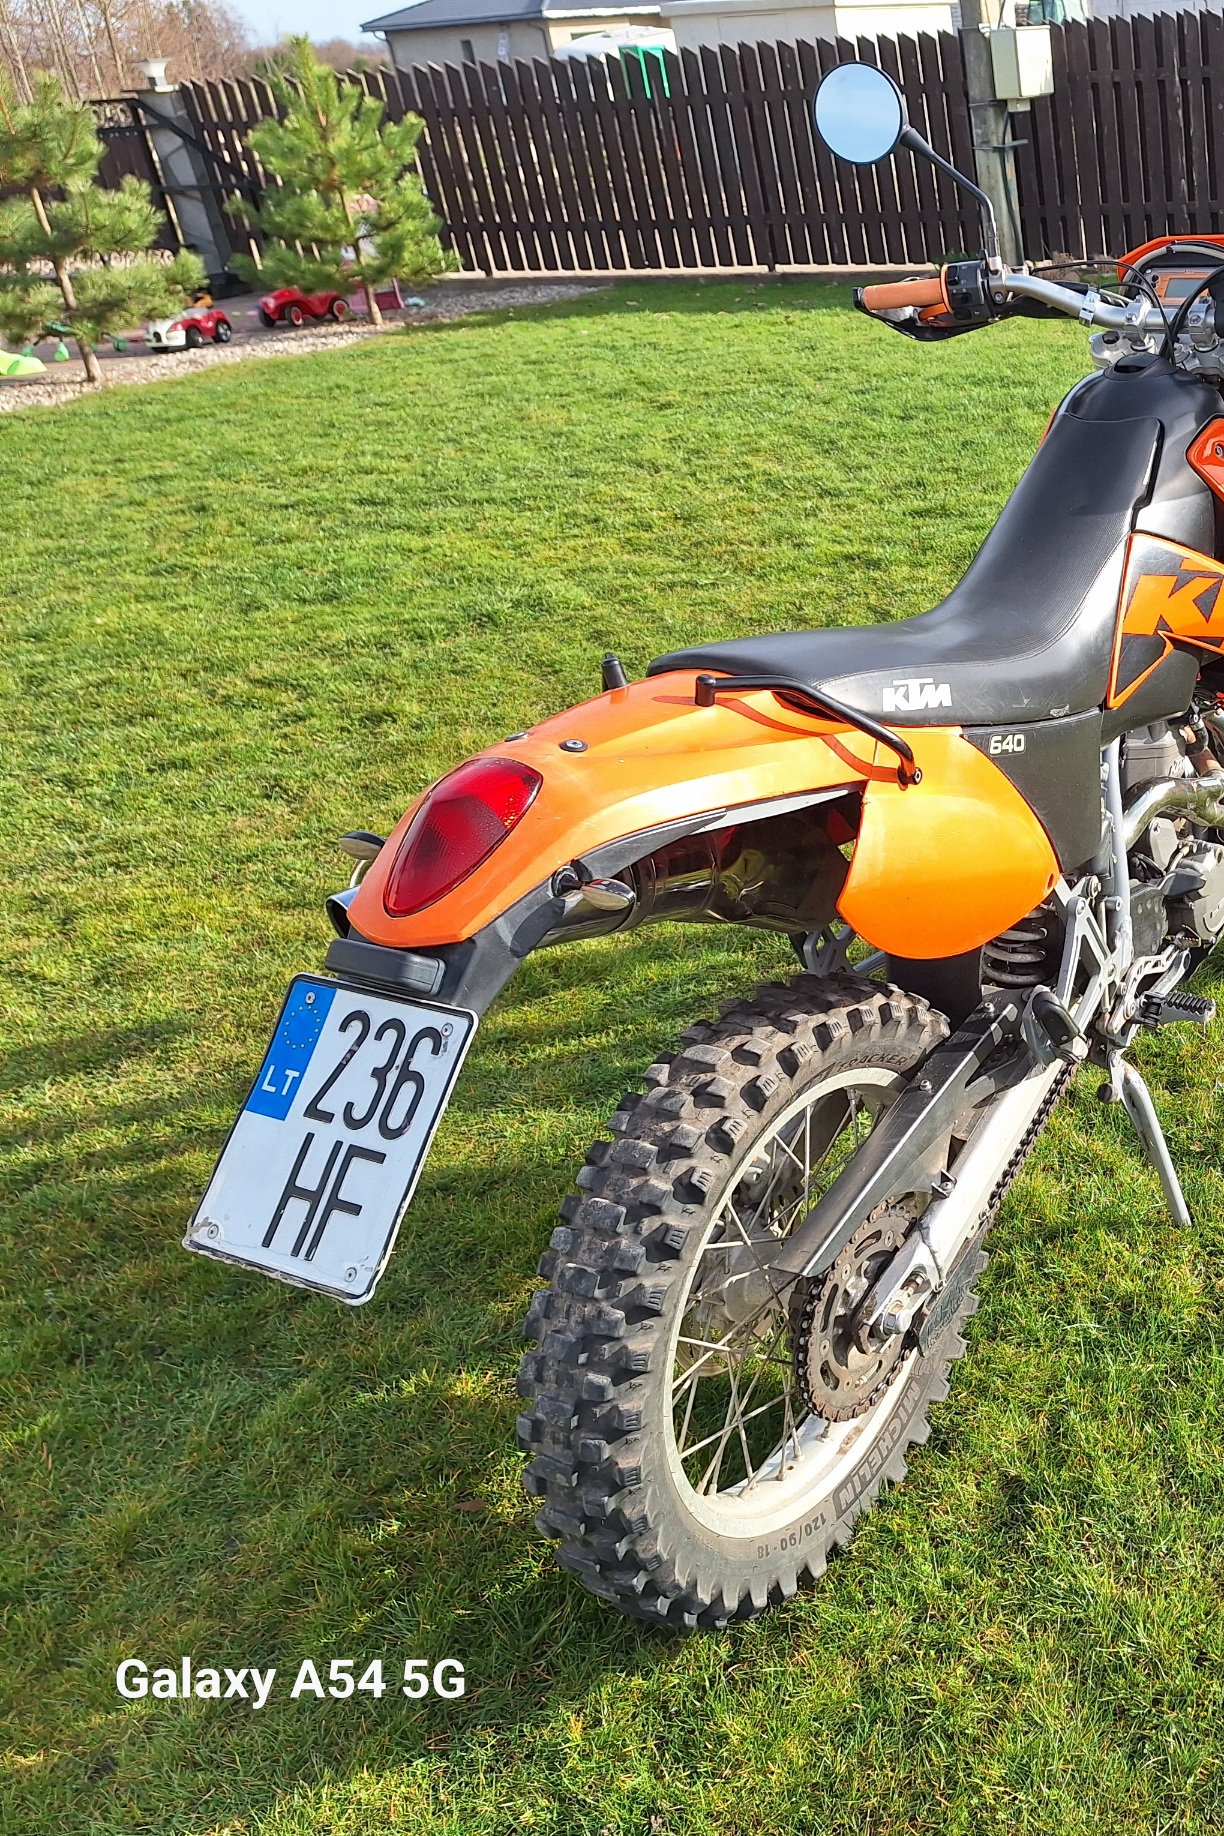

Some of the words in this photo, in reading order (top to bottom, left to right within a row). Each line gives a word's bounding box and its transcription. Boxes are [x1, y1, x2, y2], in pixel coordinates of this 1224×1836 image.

[882, 677, 952, 712] KTM
[990, 733, 1025, 755] 640
[261, 1064, 300, 1097] LT
[303, 1009, 443, 1140] 236
[261, 1131, 387, 1262] HF
[838, 1380, 922, 1512] MICHELIN
